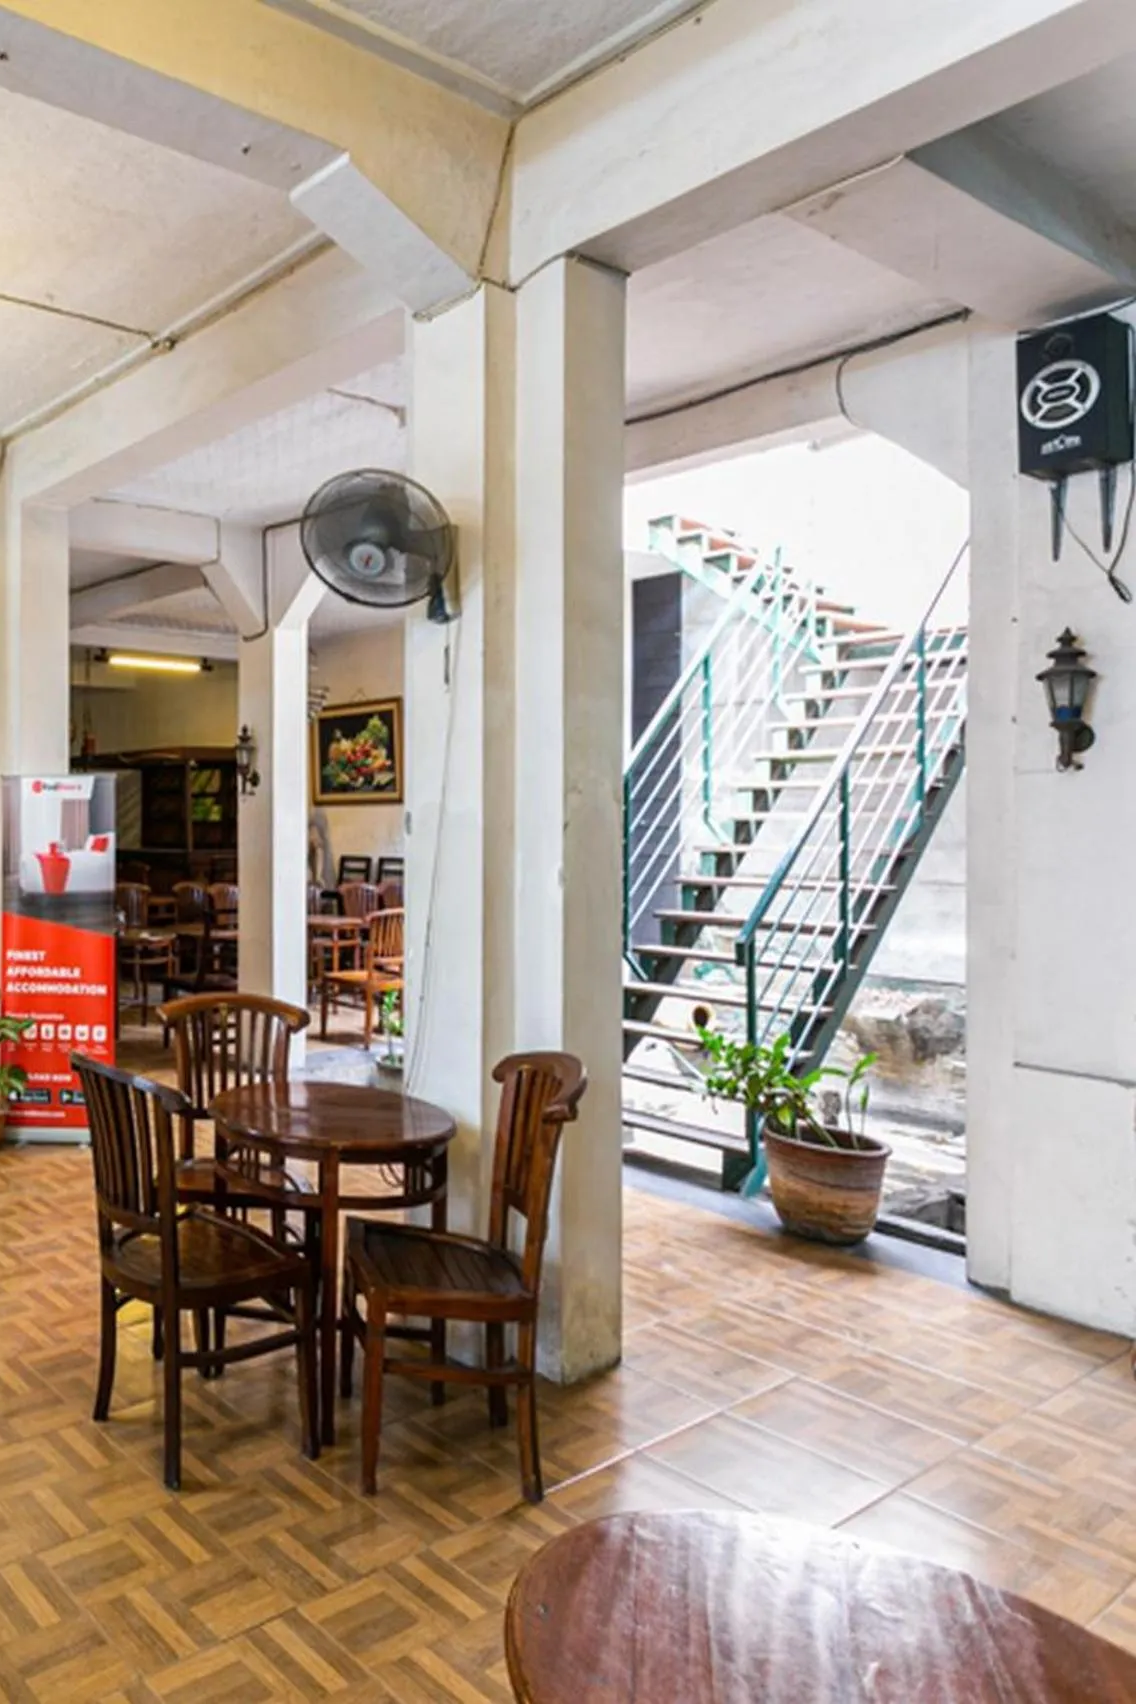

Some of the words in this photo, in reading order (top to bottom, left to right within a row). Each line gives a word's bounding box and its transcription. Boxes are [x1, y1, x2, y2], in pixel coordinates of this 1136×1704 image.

[6, 950, 46, 961] FINEST
[6, 966, 81, 979] AFFORDABLE
[6, 982, 108, 996] ACCOMMODATION
